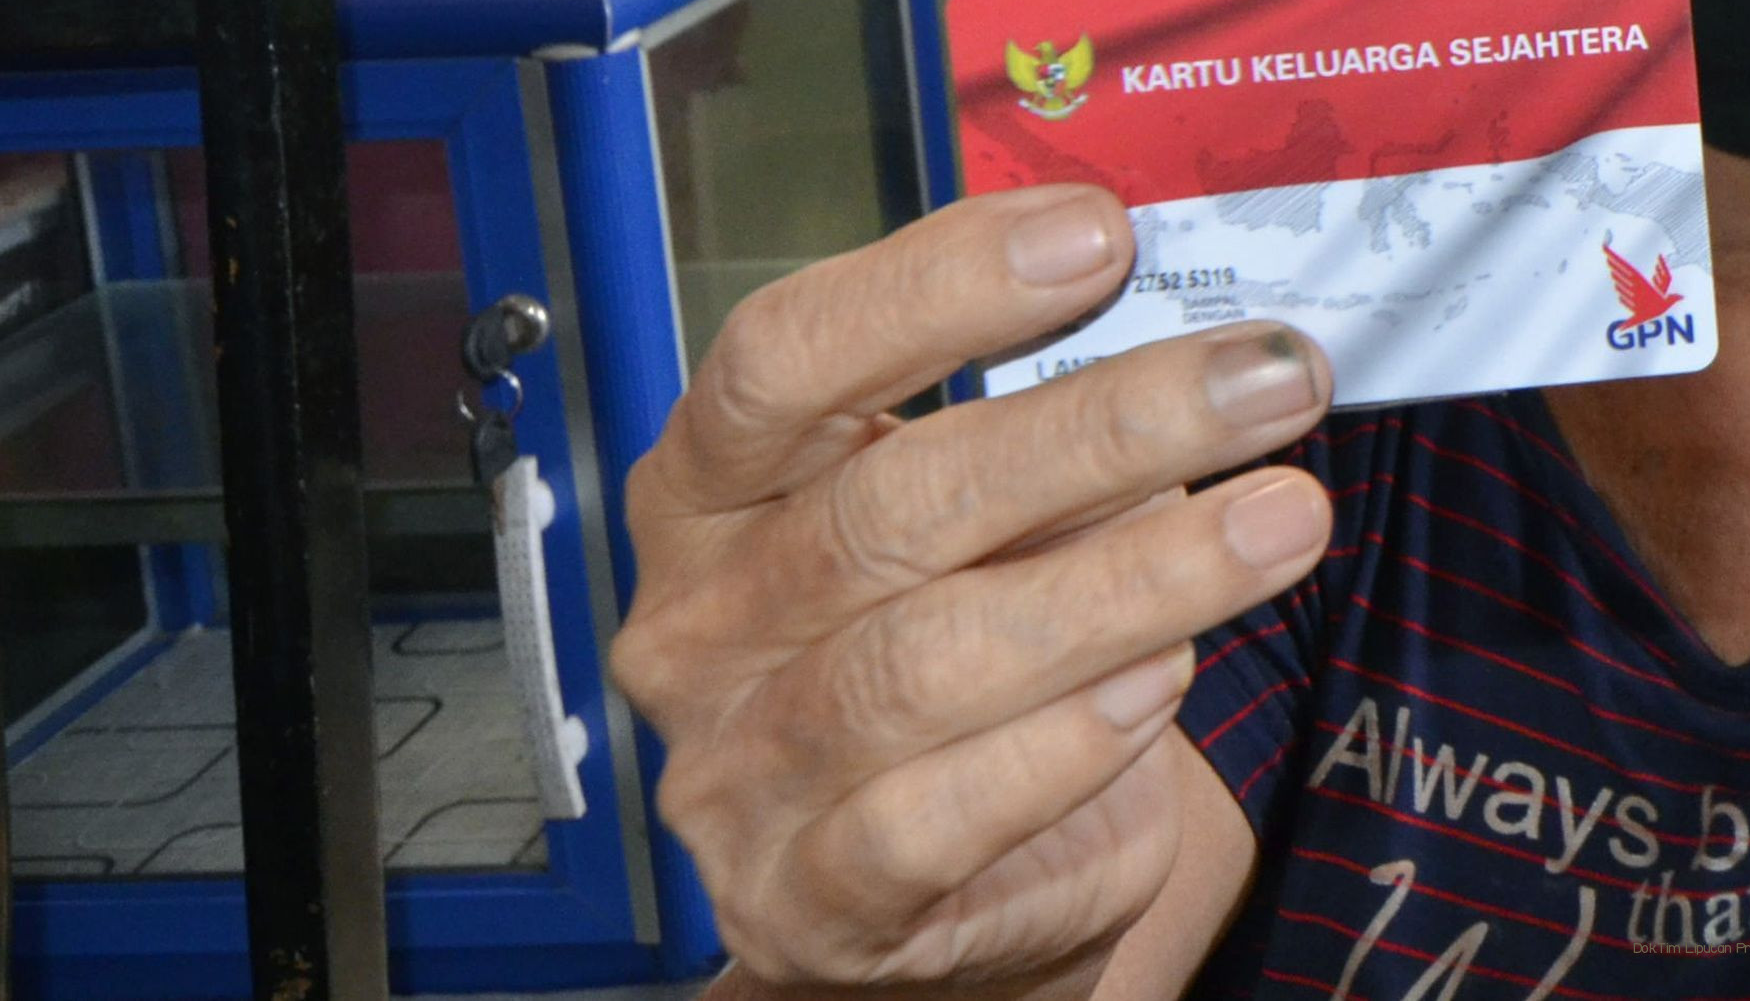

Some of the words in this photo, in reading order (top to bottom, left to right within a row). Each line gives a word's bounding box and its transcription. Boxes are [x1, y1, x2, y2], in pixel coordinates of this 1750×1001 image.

[1122, 57, 1241, 94] KARTU
[1251, 41, 1440, 83] KELUARGA
[1449, 24, 1648, 66] SEJAHTERA
[1606, 313, 1695, 350] GPN
[1306, 696, 1661, 875] Always
